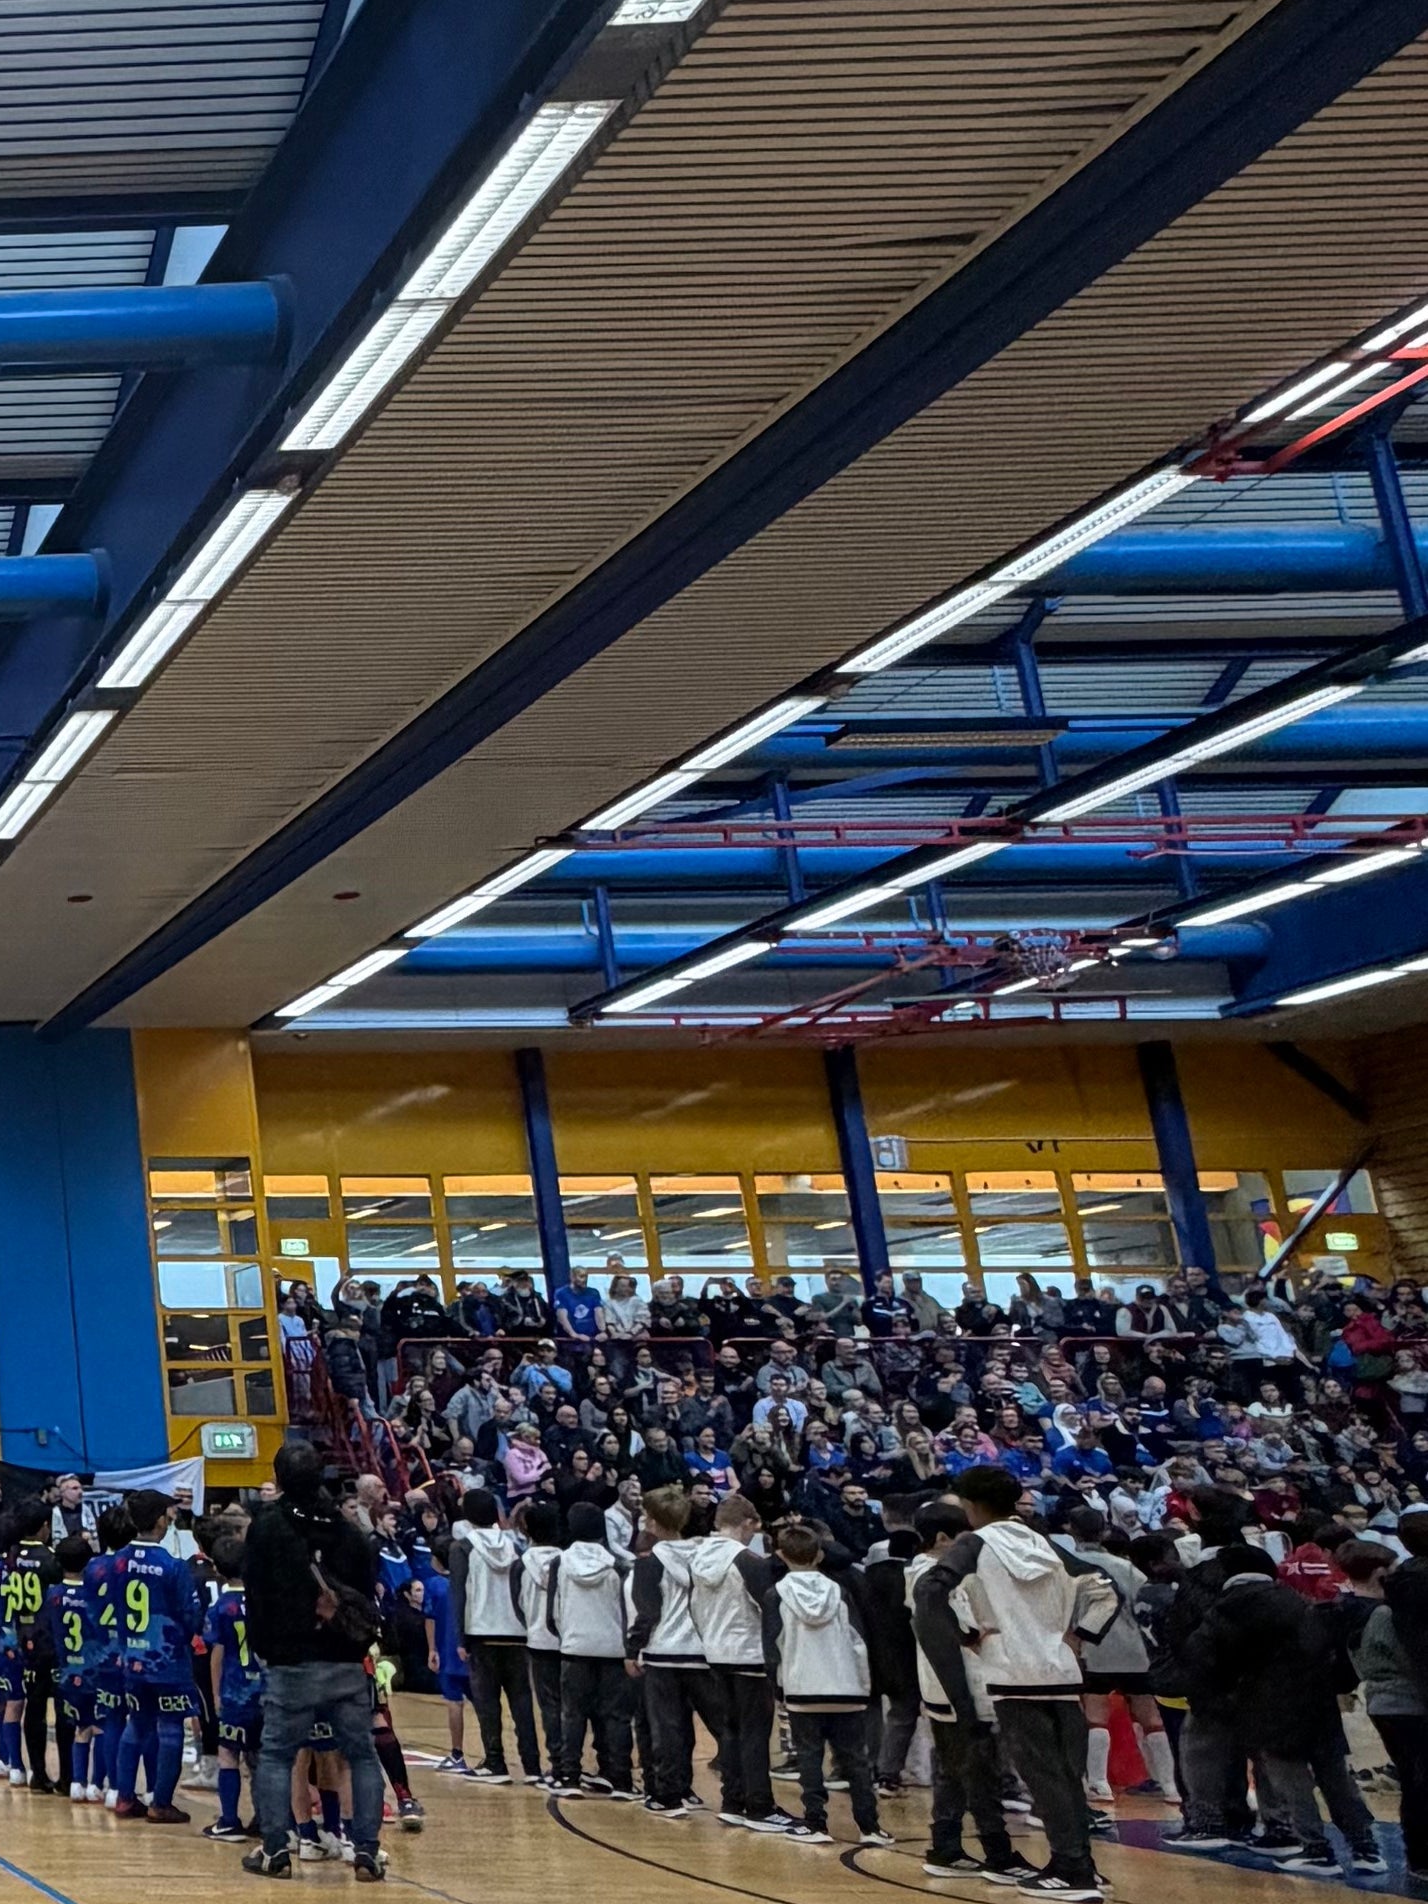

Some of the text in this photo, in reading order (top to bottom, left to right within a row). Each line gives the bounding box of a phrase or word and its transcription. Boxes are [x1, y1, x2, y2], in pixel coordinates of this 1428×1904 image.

[10, 1571, 43, 1612] 99
[126, 1579, 149, 1633] 9
[62, 1610, 83, 1652] 3
